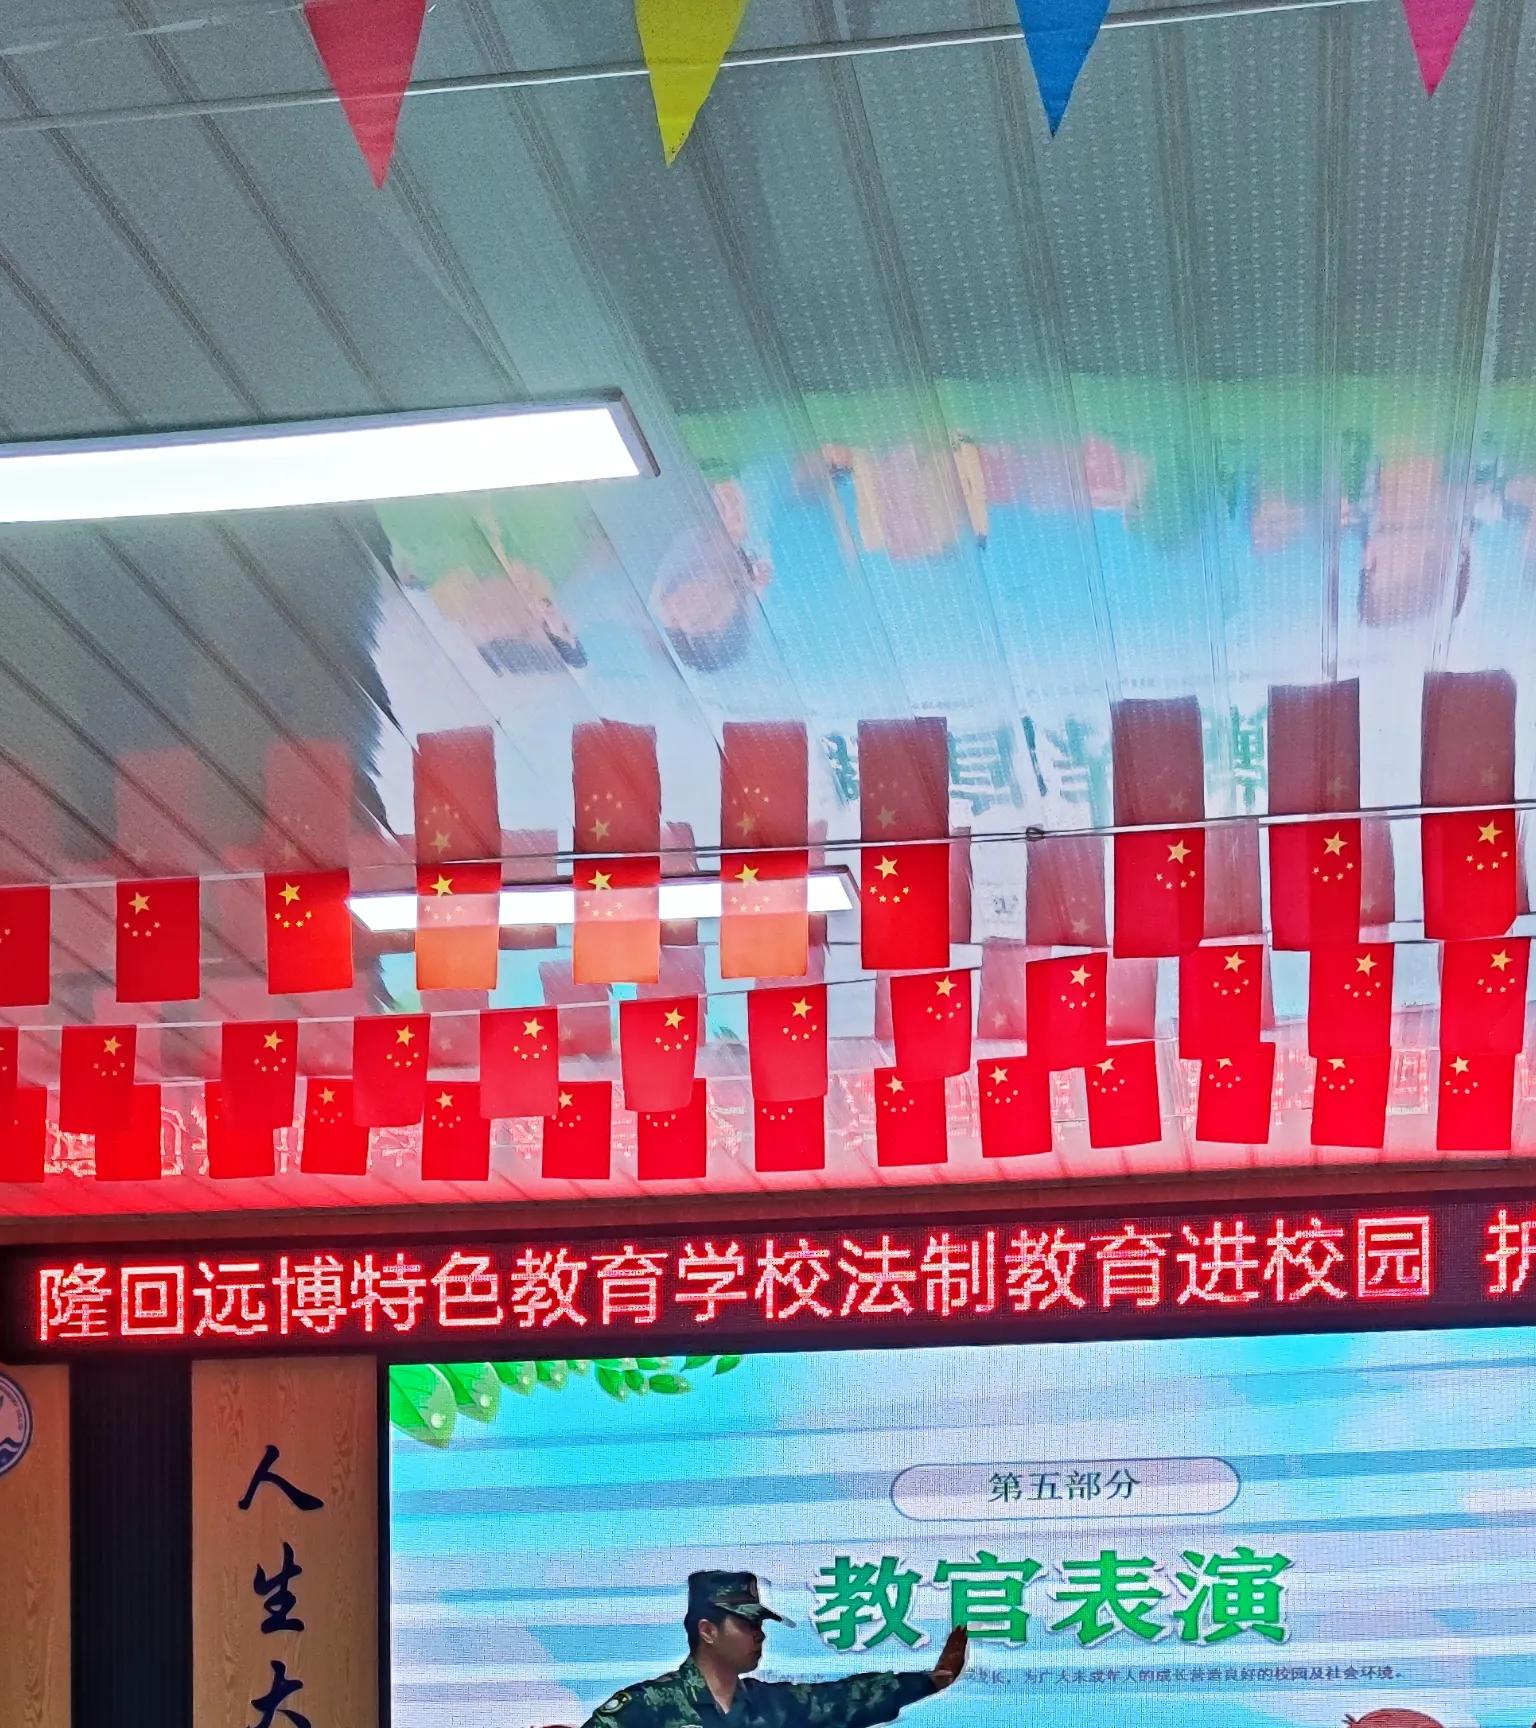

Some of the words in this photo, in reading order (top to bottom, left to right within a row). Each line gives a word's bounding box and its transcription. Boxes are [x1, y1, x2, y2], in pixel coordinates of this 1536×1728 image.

[37, 1214, 1432, 1341] 隆回远博特色教育学校法制教育进校园
[987, 1470, 1142, 1504] 第五部分
[815, 1546, 1292, 1649] 教官表演
